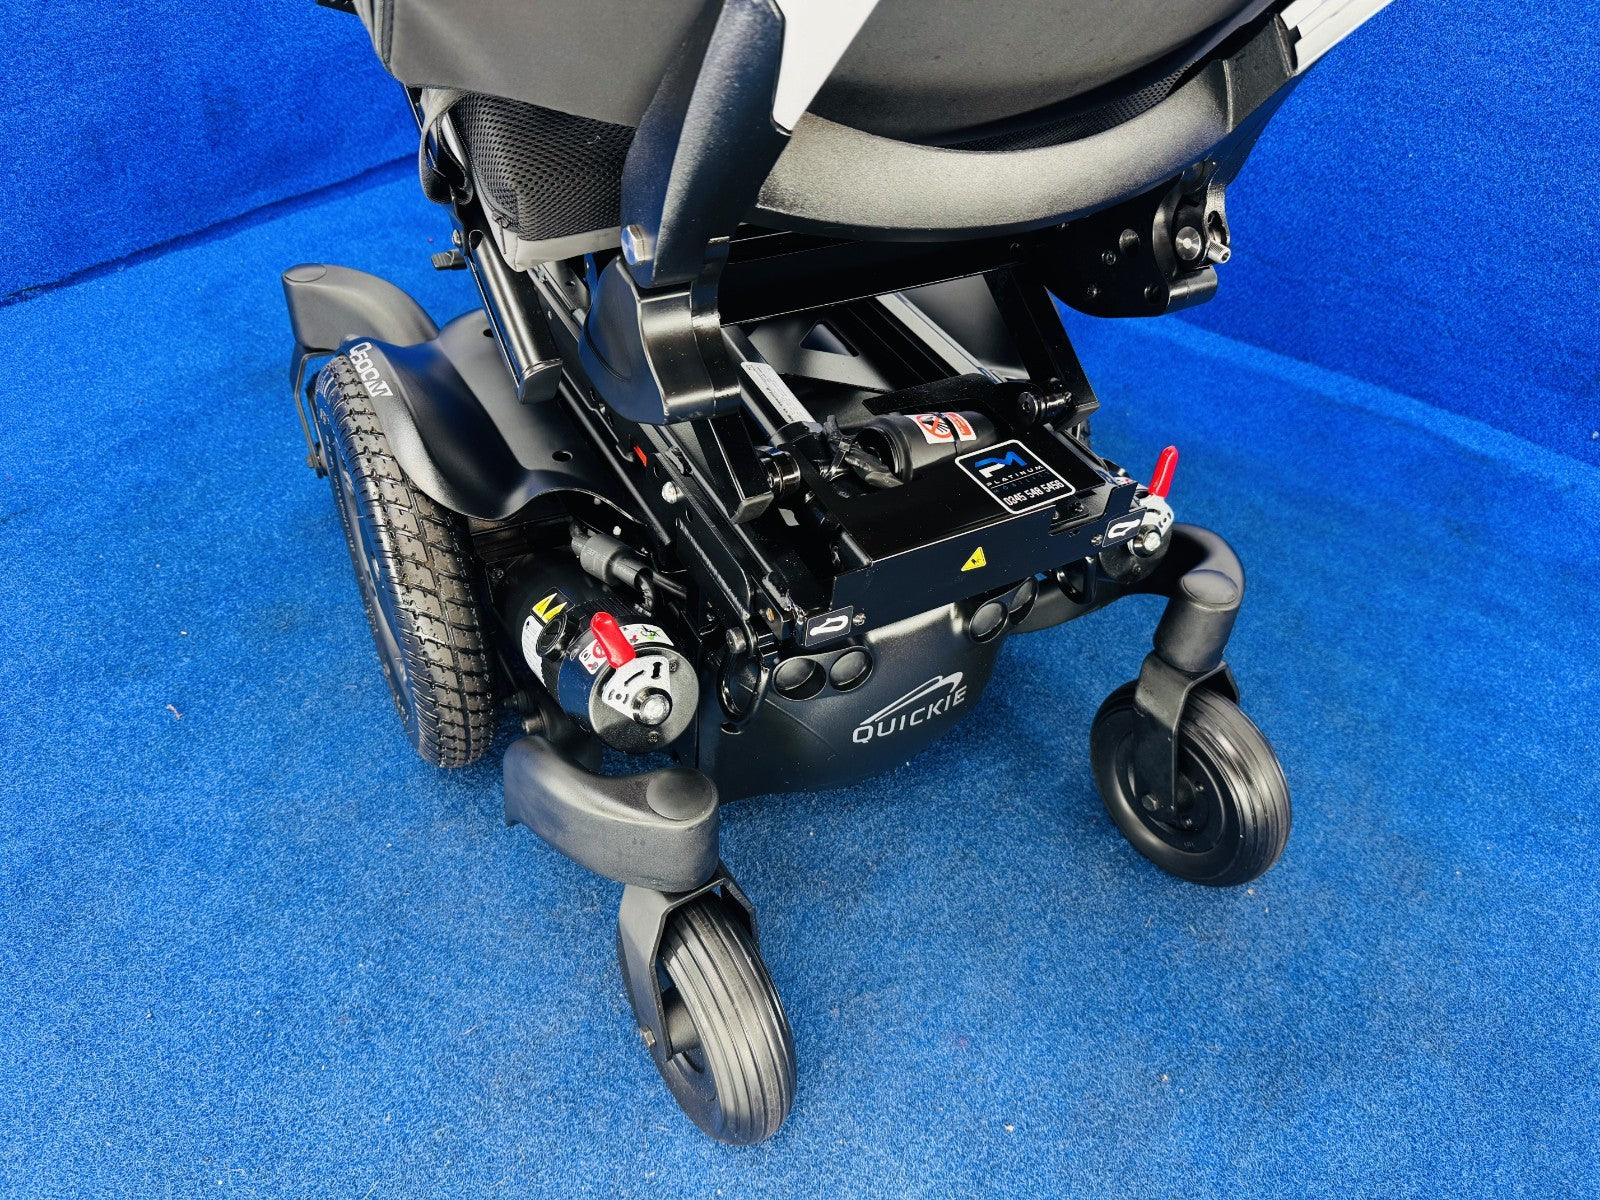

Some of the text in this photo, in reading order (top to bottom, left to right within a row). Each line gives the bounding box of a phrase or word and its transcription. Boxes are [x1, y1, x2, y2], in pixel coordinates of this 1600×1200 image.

[986, 465, 1044, 487] PLATINUM
[1002, 492, 1028, 506] 0345
[1023, 486, 1044, 498] 548
[852, 685, 968, 743] QUICKIE
